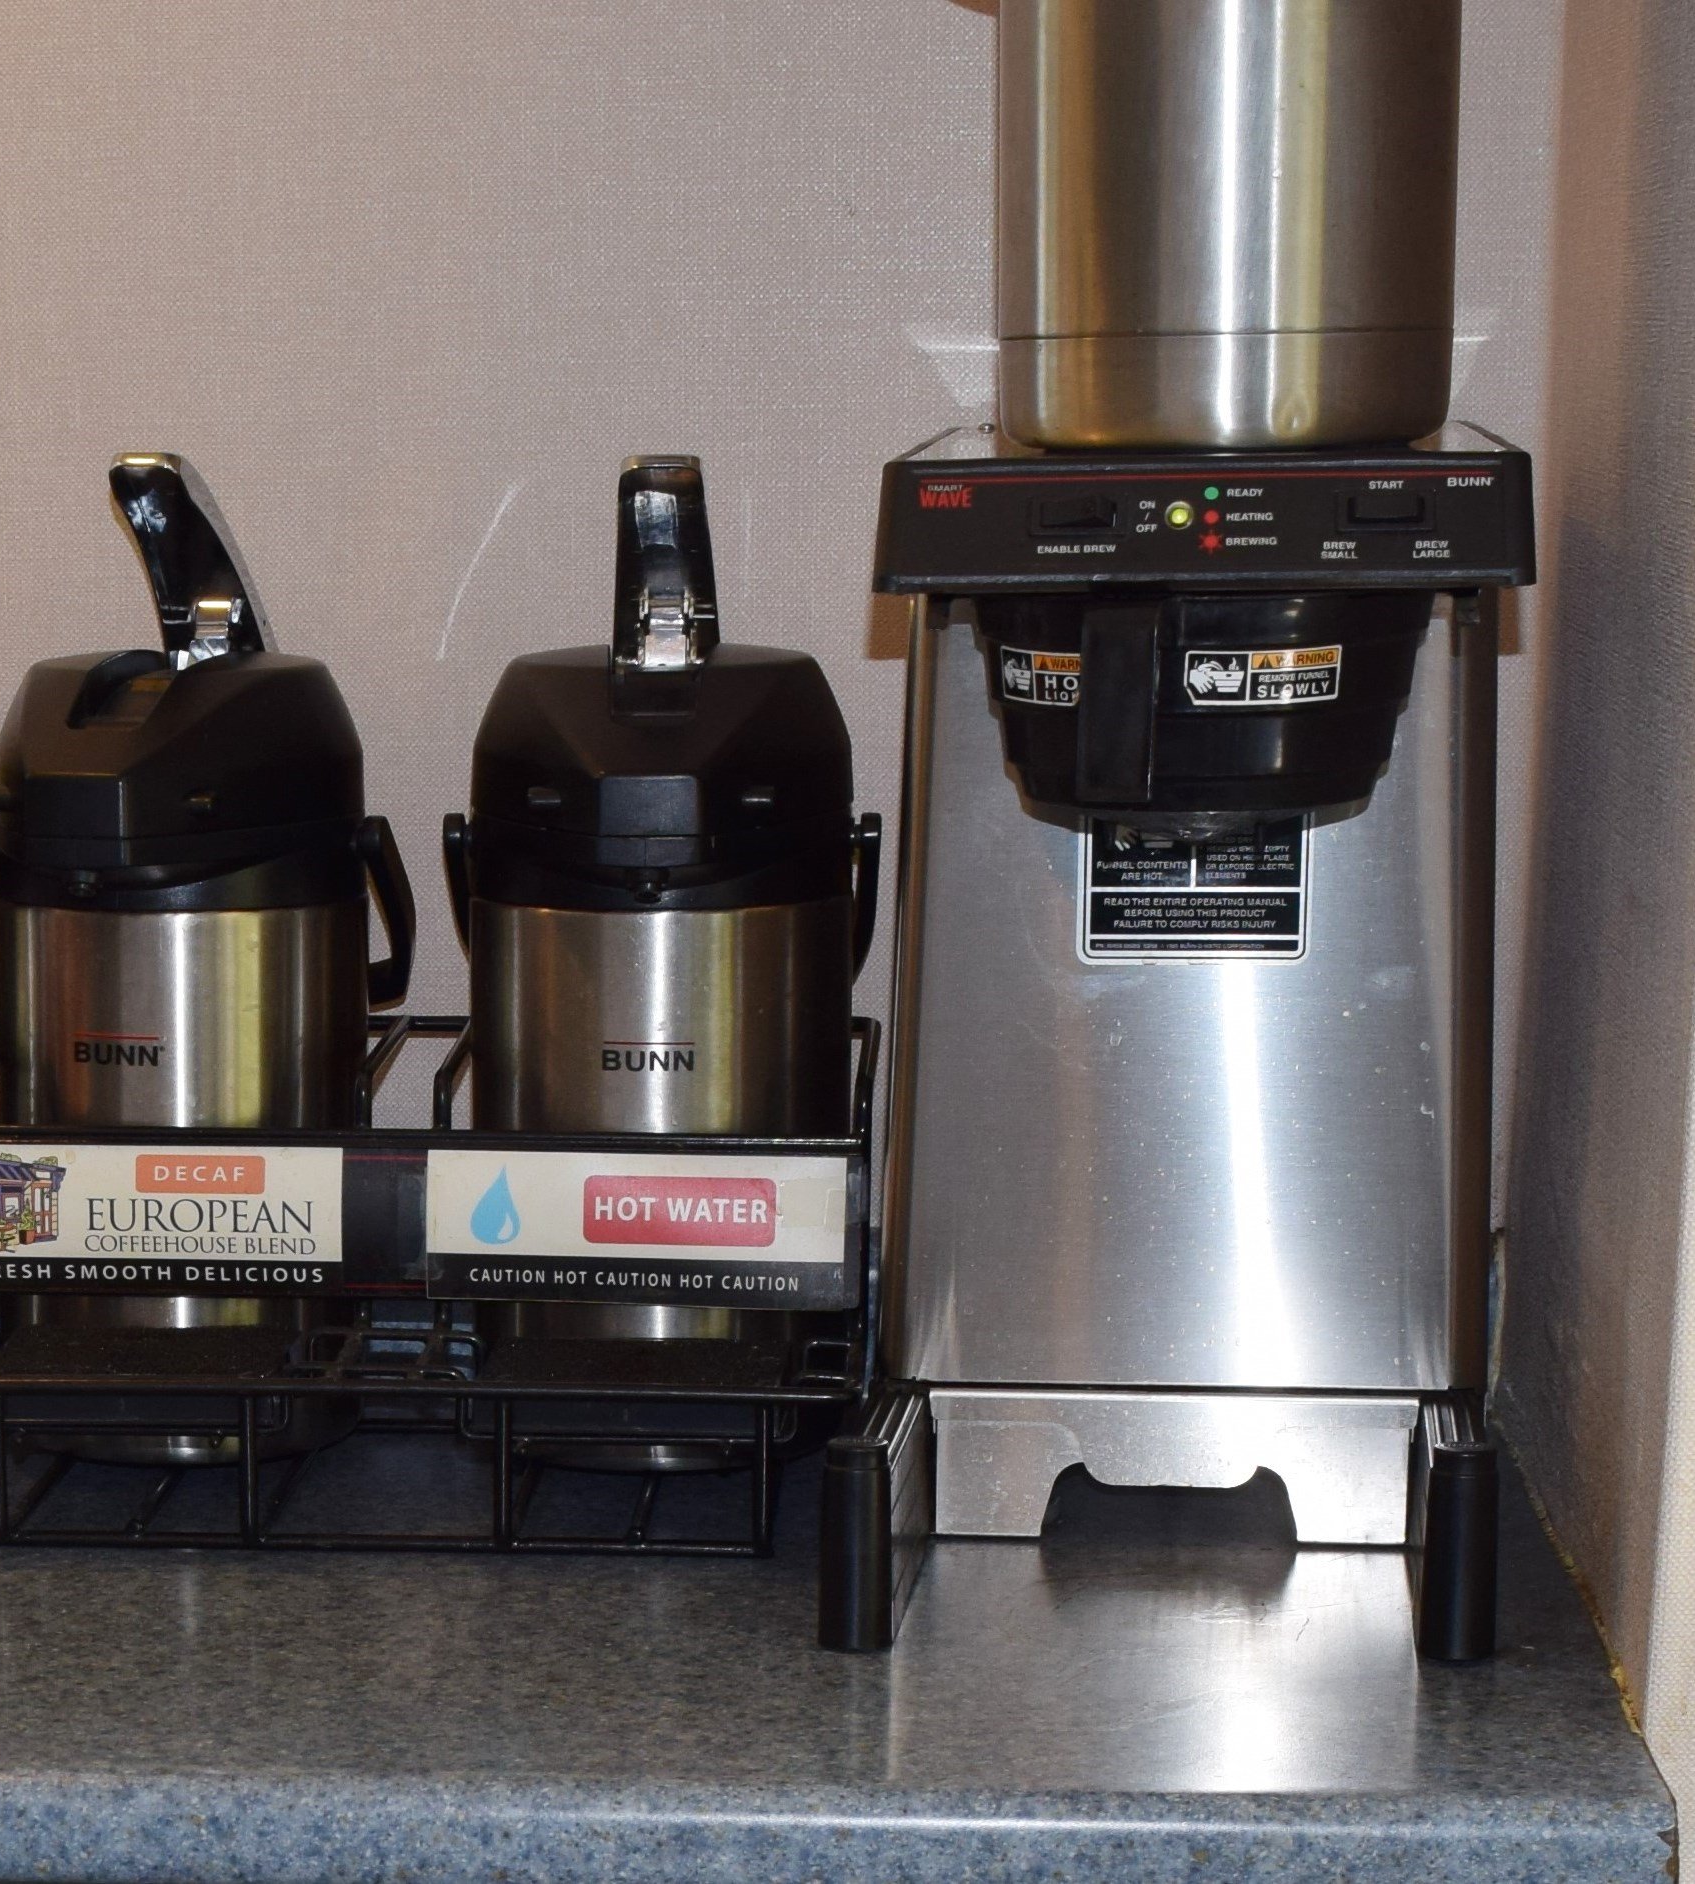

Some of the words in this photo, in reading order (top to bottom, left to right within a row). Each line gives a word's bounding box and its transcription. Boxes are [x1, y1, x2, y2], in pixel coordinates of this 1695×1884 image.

[1369, 481, 1404, 489] START
[1447, 477, 1492, 487] BUNN
[1226, 488, 1263, 497] READY
[920, 487, 973, 508] WAVE
[1139, 501, 1155, 510] ON
[1226, 512, 1274, 521] HEATING
[1136, 524, 1157, 533] OFF
[1225, 537, 1277, 546] BREWING
[1323, 541, 1356, 550] BREW
[1415, 540, 1449, 549] BREW
[1037, 545, 1081, 554] ENABLE
[1083, 544, 1117, 553] BREW
[1320, 551, 1358, 559] SMALL
[1413, 550, 1450, 559] LARGE
[1258, 673, 1296, 682] REMOVE
[1257, 681, 1330, 698] SLOWLY
[1137, 861, 1188, 869] CONTENTS
[1121, 872, 1141, 880] ARE
[1144, 872, 1163, 880] HOT
[1104, 898, 1131, 906] READ
[1132, 898, 1150, 906] THE
[1153, 898, 1187, 906] ENTIRE
[1190, 898, 1244, 906] OPERATING
[1247, 898, 1287, 906] MANUAL
[1124, 909, 1162, 917] BEFORE
[1165, 909, 1195, 917] USING
[1196, 909, 1218, 917] THIS
[1220, 909, 1267, 917] PRODUCT
[1114, 920, 1153, 928] FAILURE
[1155, 920, 1168, 928] TO
[1170, 920, 1209, 928] COMPLY
[1211, 920, 1240, 928] RISKS
[1242, 920, 1276, 928] INJURY
[74, 1041, 160, 1067] BUNN
[602, 1049, 694, 1072] BUNN
[154, 1165, 245, 1182] DECAF
[595, 1196, 659, 1222] HOT
[667, 1197, 767, 1224] WATER
[86, 1197, 314, 1234] EUROPEAN
[84, 1235, 237, 1254] COFFEEHOUSE
[244, 1237, 316, 1255] BLEND
[64, 1264, 172, 1281] SMOOTH
[185, 1266, 323, 1283] DELICIOUS
[469, 1267, 545, 1284] CAUTION
[555, 1270, 587, 1286] HOT
[595, 1271, 671, 1288] CAUTION
[680, 1273, 713, 1289] HOT
[721, 1274, 799, 1292] CAUTION
